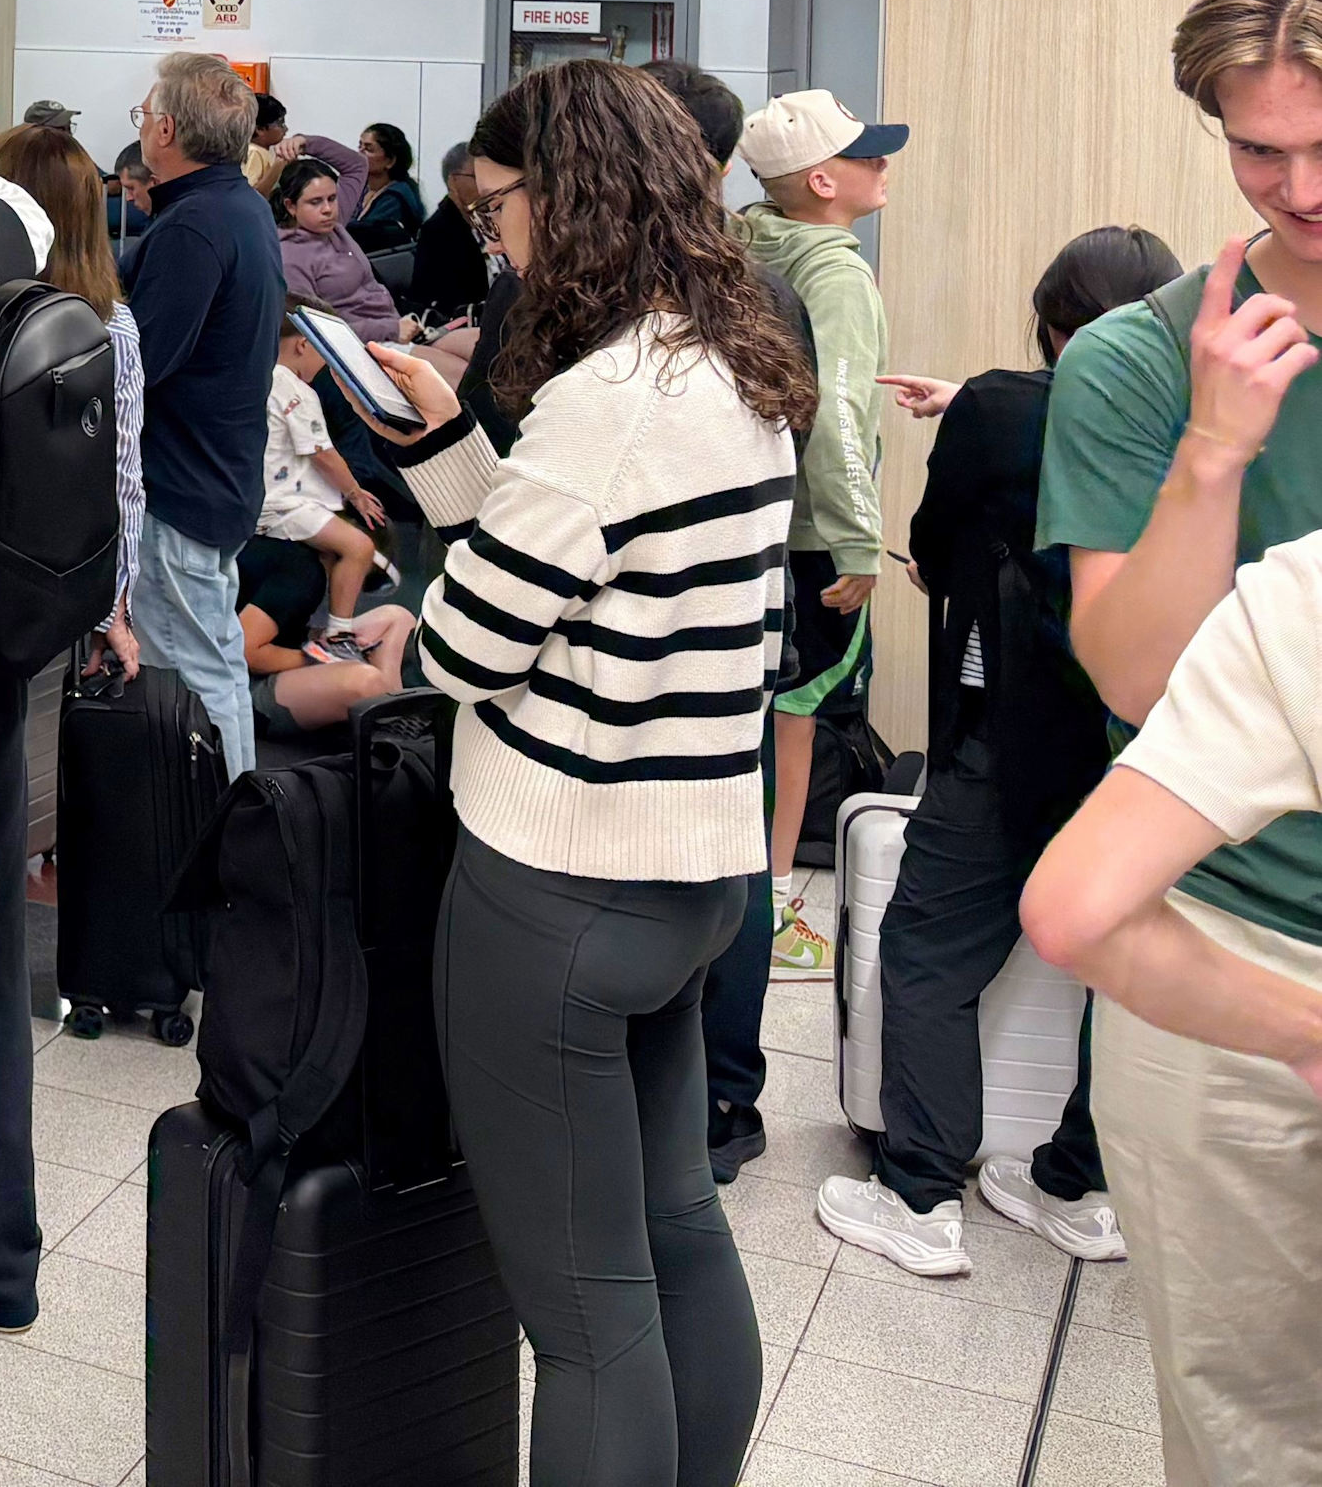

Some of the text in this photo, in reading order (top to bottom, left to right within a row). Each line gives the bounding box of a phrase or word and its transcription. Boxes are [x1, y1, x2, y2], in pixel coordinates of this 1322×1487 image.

[215, 14, 237, 22] AED
[523, 11, 589, 24] FIRE HOSE
[835, 357, 848, 383] NIKE
